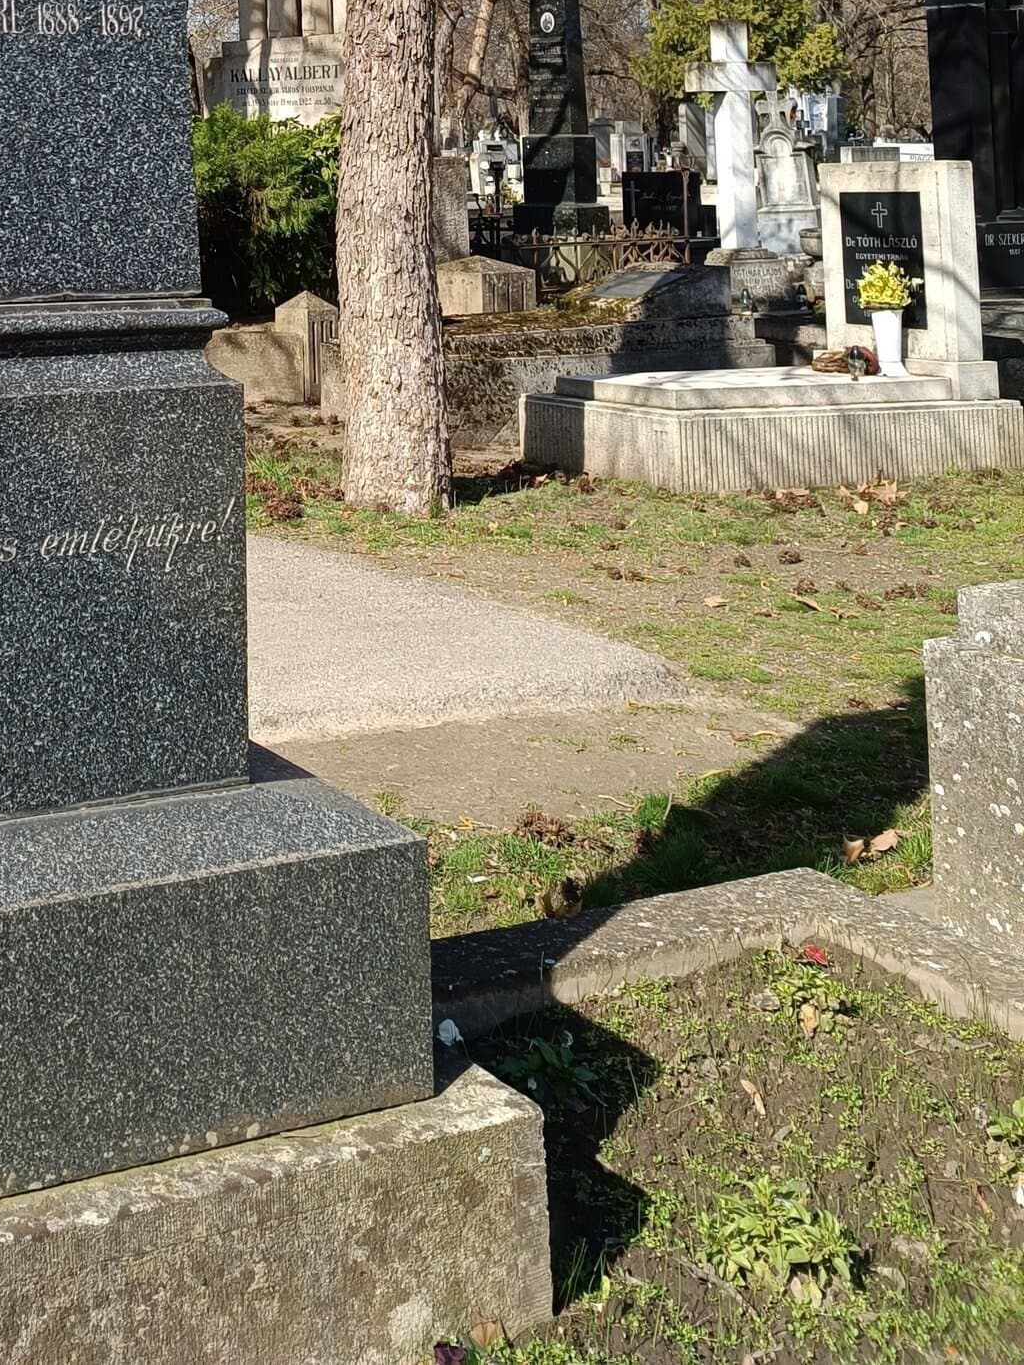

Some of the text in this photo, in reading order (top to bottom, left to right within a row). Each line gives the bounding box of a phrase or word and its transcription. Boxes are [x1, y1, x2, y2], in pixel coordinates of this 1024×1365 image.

[37, 2, 80, 35] 1888
[284, 64, 341, 81] ALBERT
[856, 234, 881, 248] TÓTH
[883, 234, 917, 249] LÁSZLÓ
